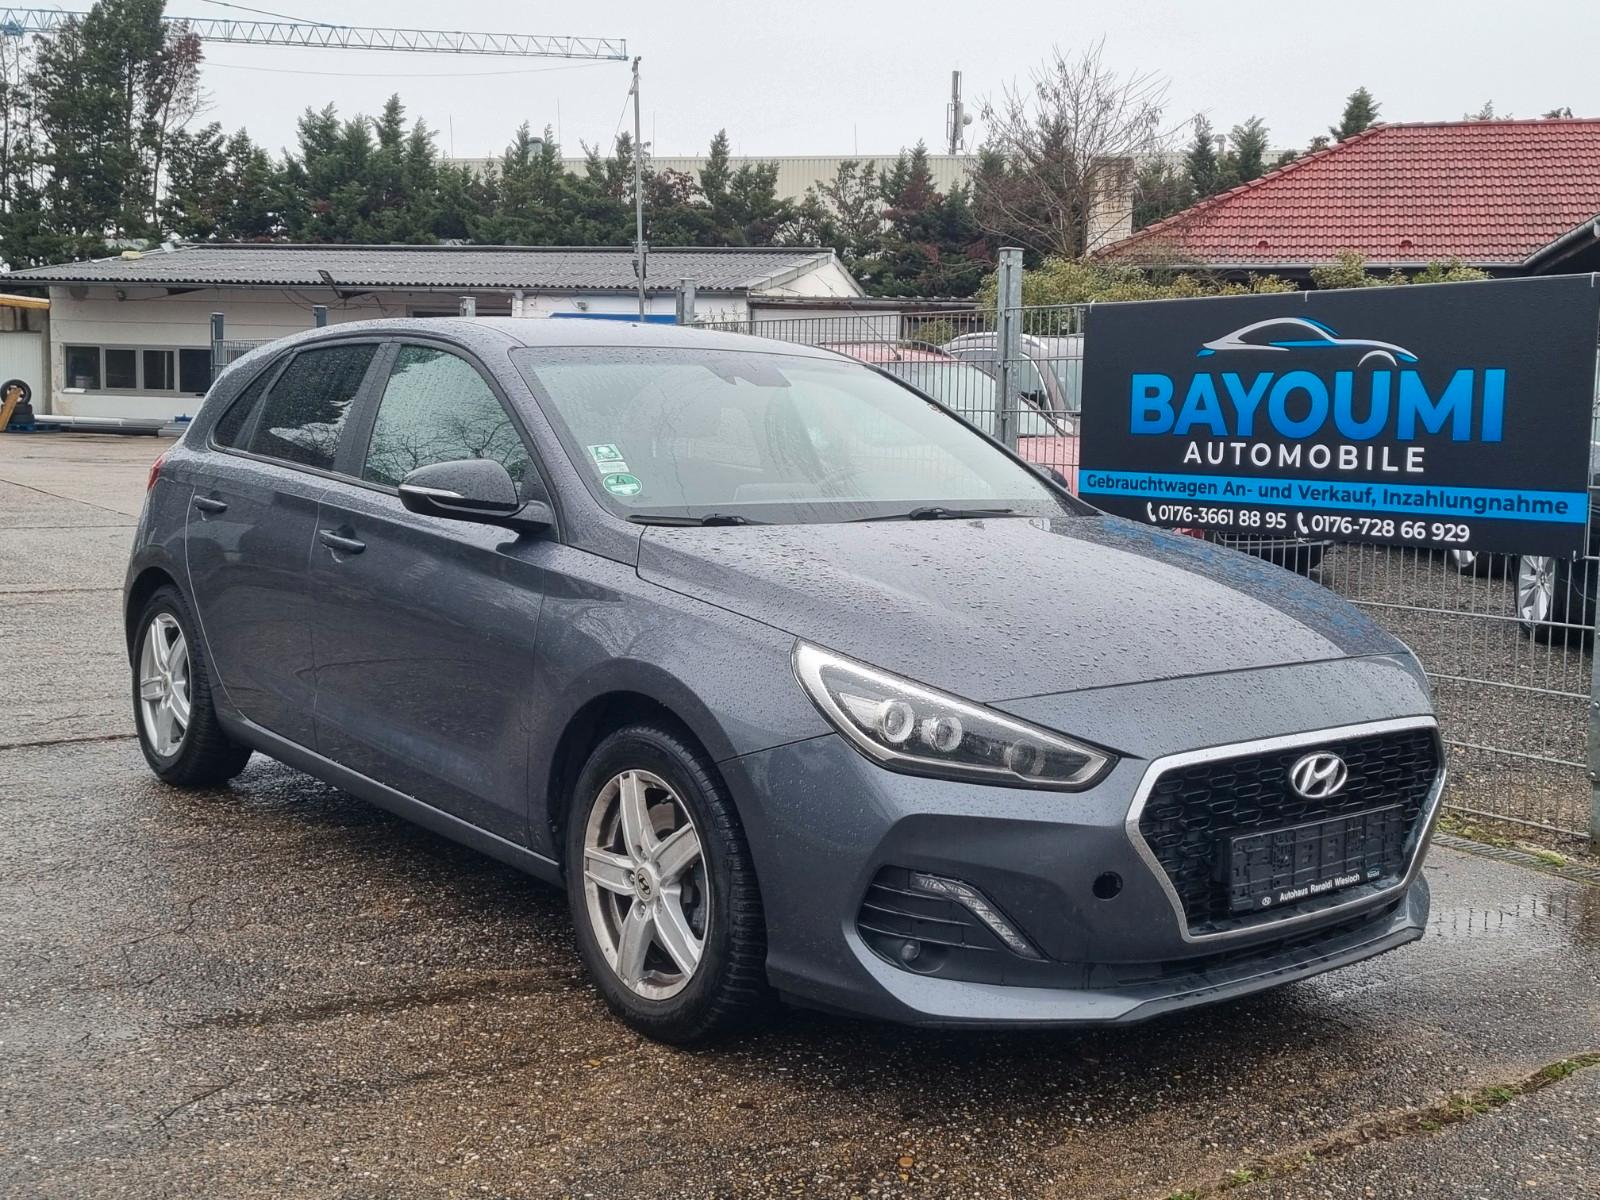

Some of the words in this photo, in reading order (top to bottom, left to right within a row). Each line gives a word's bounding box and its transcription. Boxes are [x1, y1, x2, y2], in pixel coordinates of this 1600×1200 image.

[1130, 368, 1506, 442] BAYOUMI
[1183, 441, 1425, 473] AUTOMOBILE
[1087, 474, 1217, 497] Gebrauchtwagen
[1223, 481, 1252, 496] An-
[1258, 483, 1291, 499] und
[1299, 484, 1376, 507] Verkauf,
[1383, 488, 1569, 515] Inzahlungnahme
[1159, 505, 1234, 525] 0176-3661
[1239, 510, 1261, 527] 88
[1265, 512, 1287, 529] 95
[1312, 515, 1395, 537] 0176-728
[1400, 521, 1426, 540] 66
[1431, 523, 1470, 543] 929
[1280, 887, 1308, 902] Autohaus
[1334, 873, 1360, 887] Wiesloch
